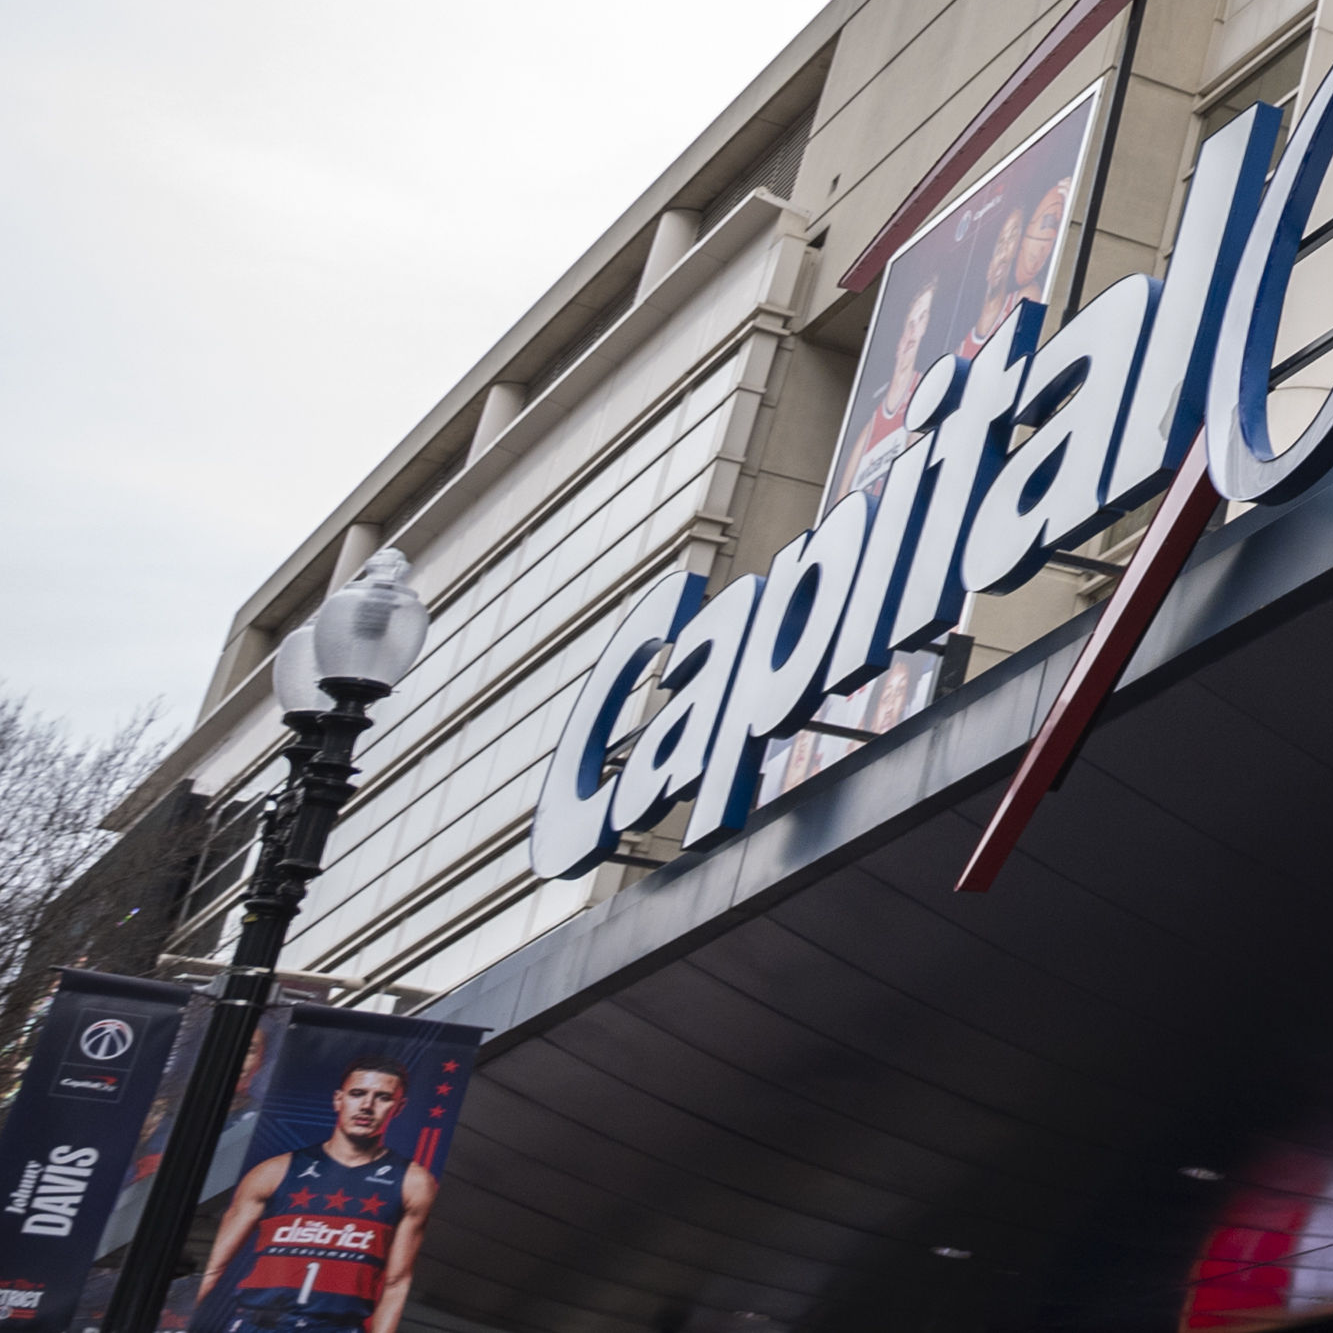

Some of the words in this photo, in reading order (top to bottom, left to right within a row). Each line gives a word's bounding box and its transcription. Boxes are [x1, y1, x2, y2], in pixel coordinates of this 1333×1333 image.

[4, 1159, 45, 1215] Johnny
[20, 1145, 99, 1238] DAVIS
[272, 1217, 376, 1251] district
[296, 1262, 321, 1306] 1
